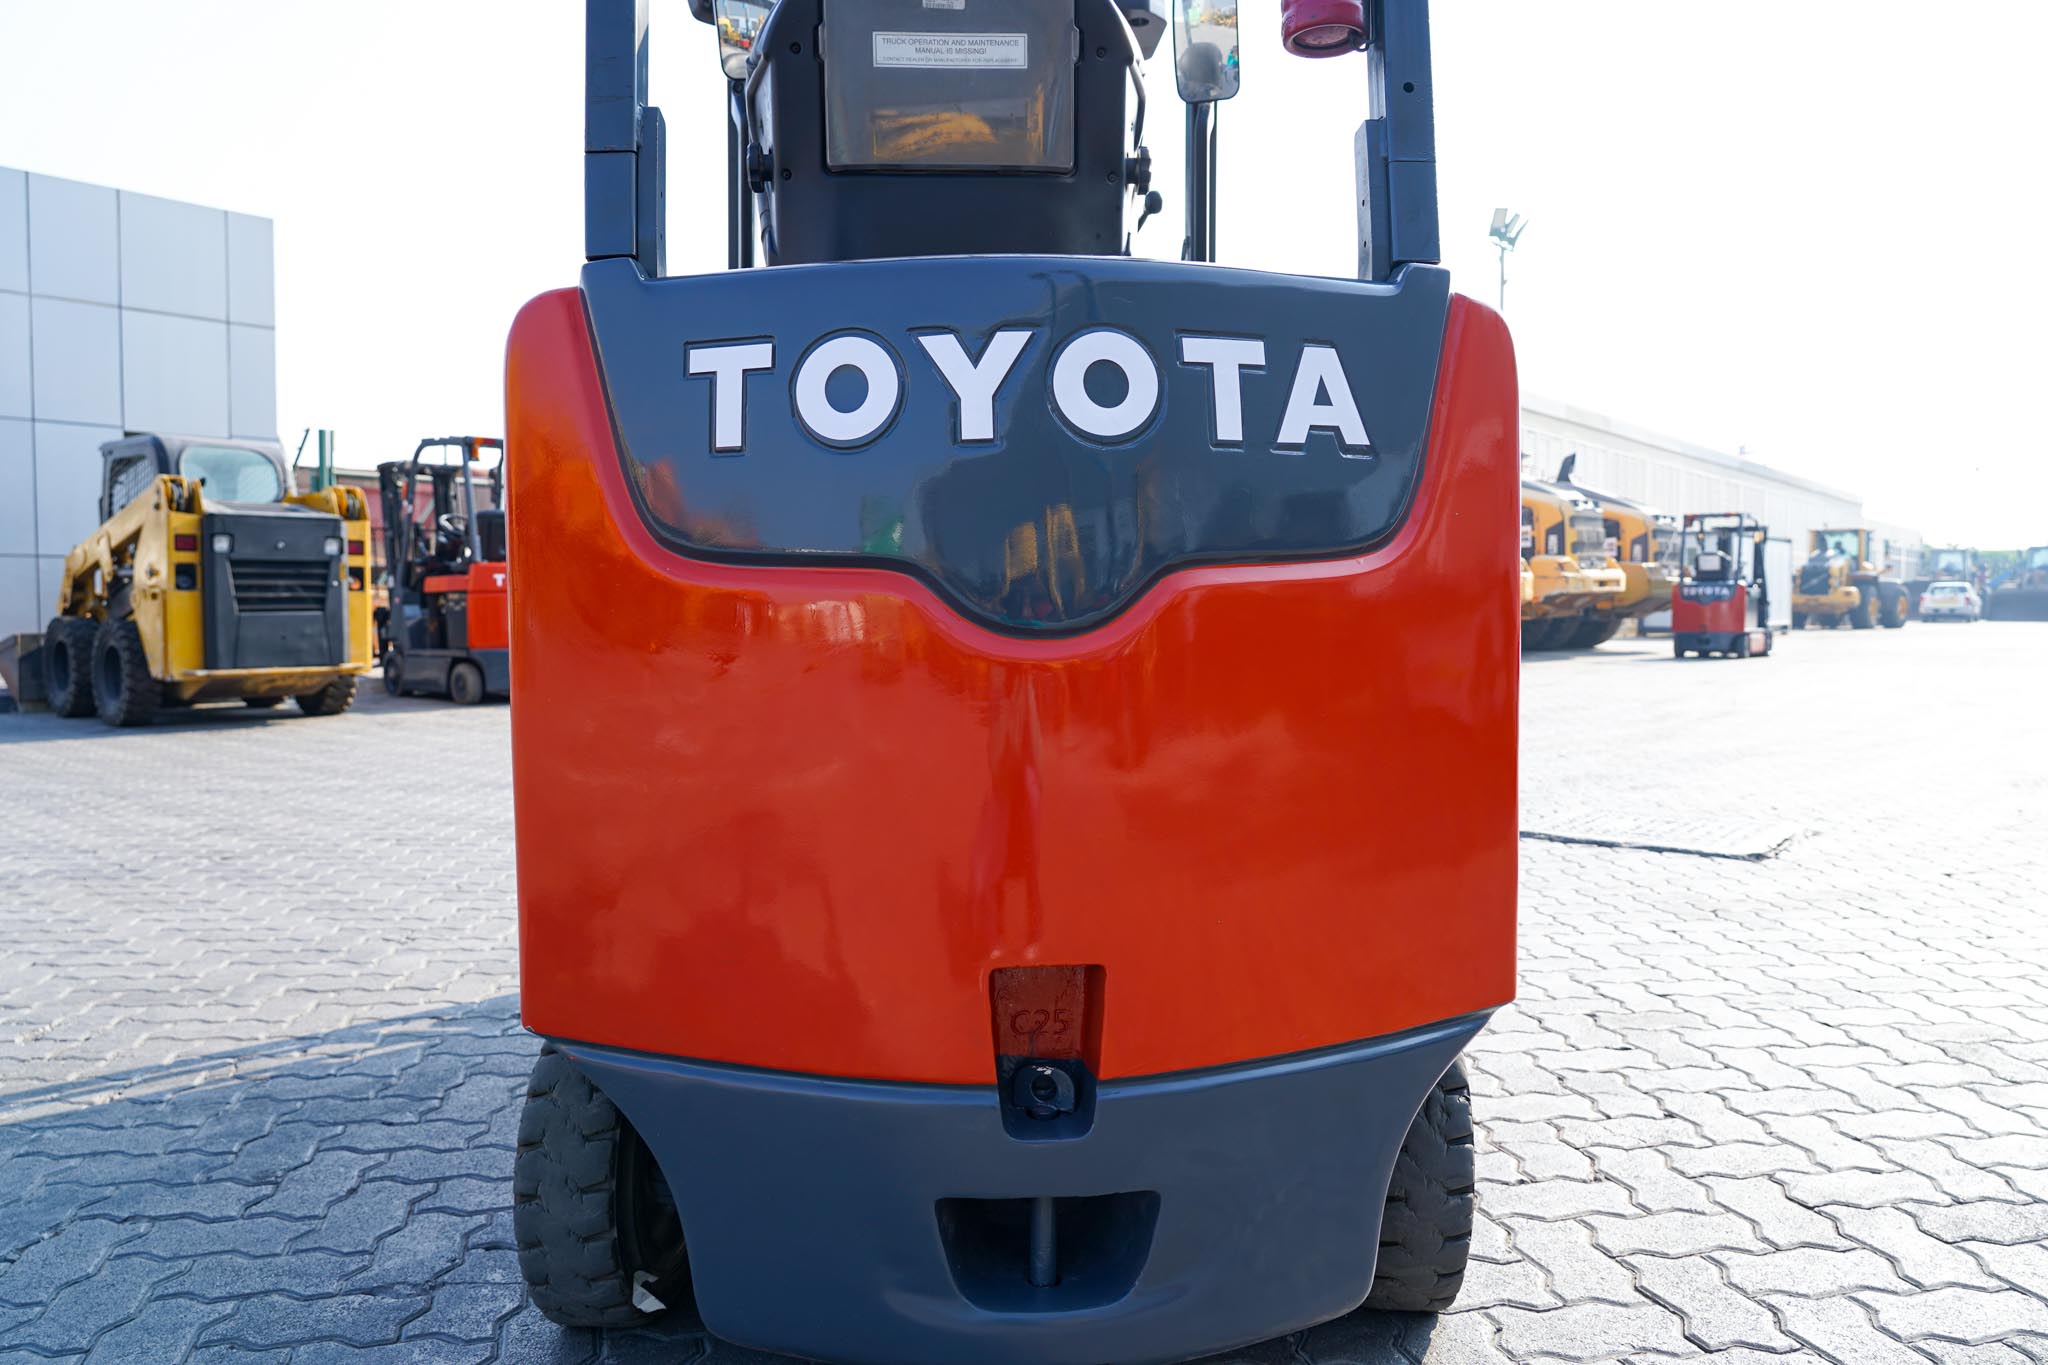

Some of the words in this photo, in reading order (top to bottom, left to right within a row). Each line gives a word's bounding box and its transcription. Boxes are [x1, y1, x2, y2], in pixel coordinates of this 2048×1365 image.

[907, 38, 950, 46] OPERATION
[967, 39, 1020, 47] MAINTENANCE
[946, 47, 953, 55] IS
[954, 47, 987, 55] MISSING!
[687, 329, 1373, 451] TOYOTA
